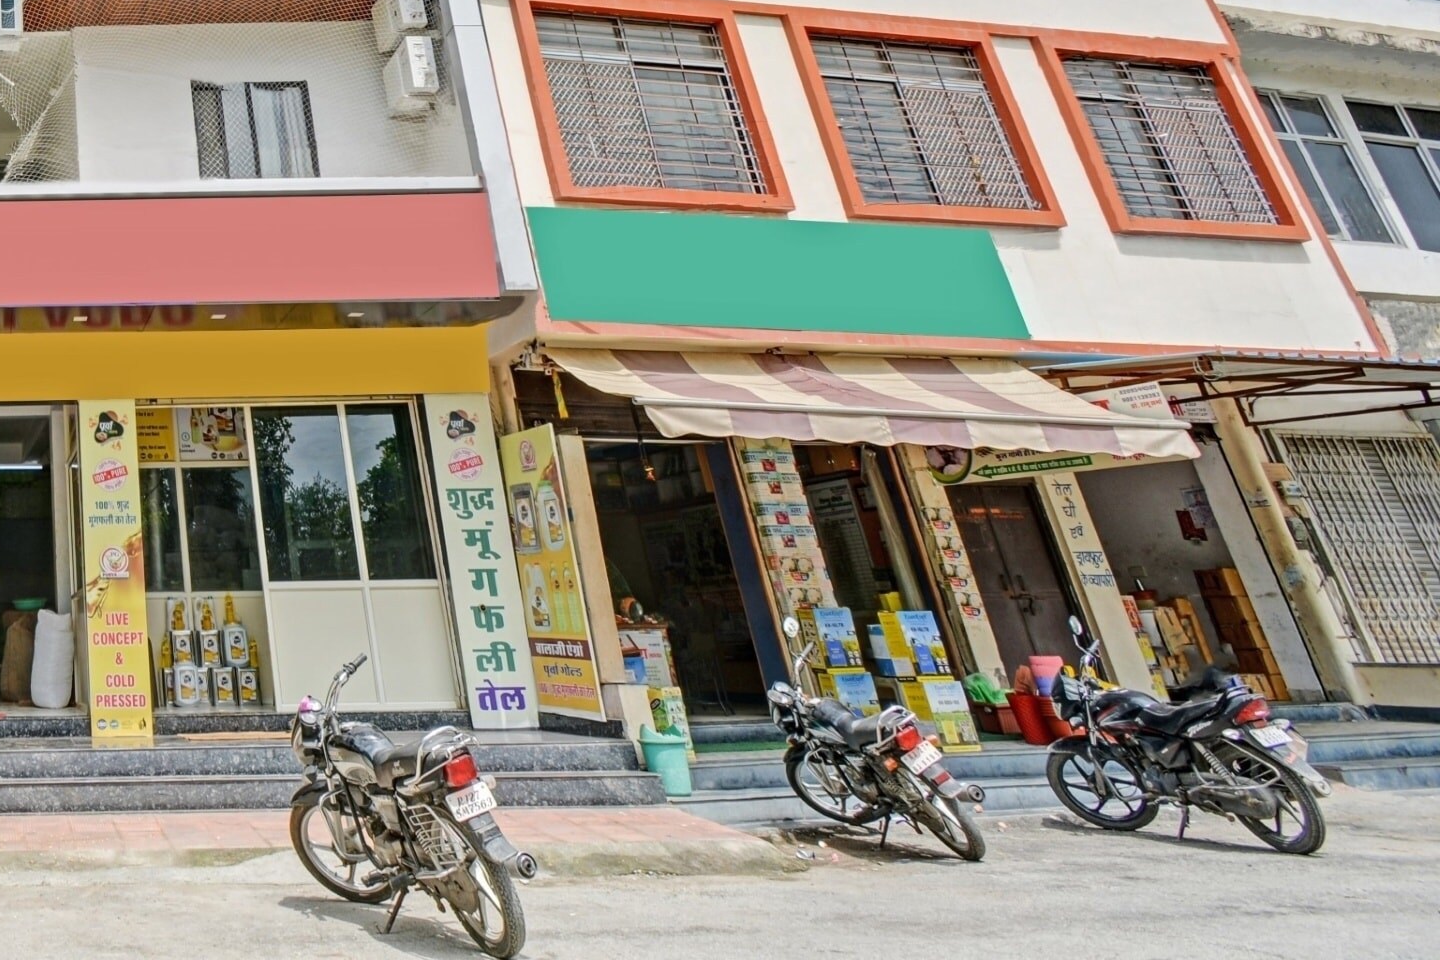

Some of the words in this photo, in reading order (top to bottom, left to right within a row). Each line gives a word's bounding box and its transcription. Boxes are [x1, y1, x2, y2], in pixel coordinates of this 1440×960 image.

[1051, 479, 1073, 496] तेल
[446, 487, 494, 519] शुद्ध
[105, 612, 129, 626] LIVE
[92, 631, 144, 645] CONCEPT
[115, 651, 123, 665] &
[105, 674, 135, 688] COLD
[96, 694, 146, 708] PRESSED
[475, 679, 527, 711] तेल
